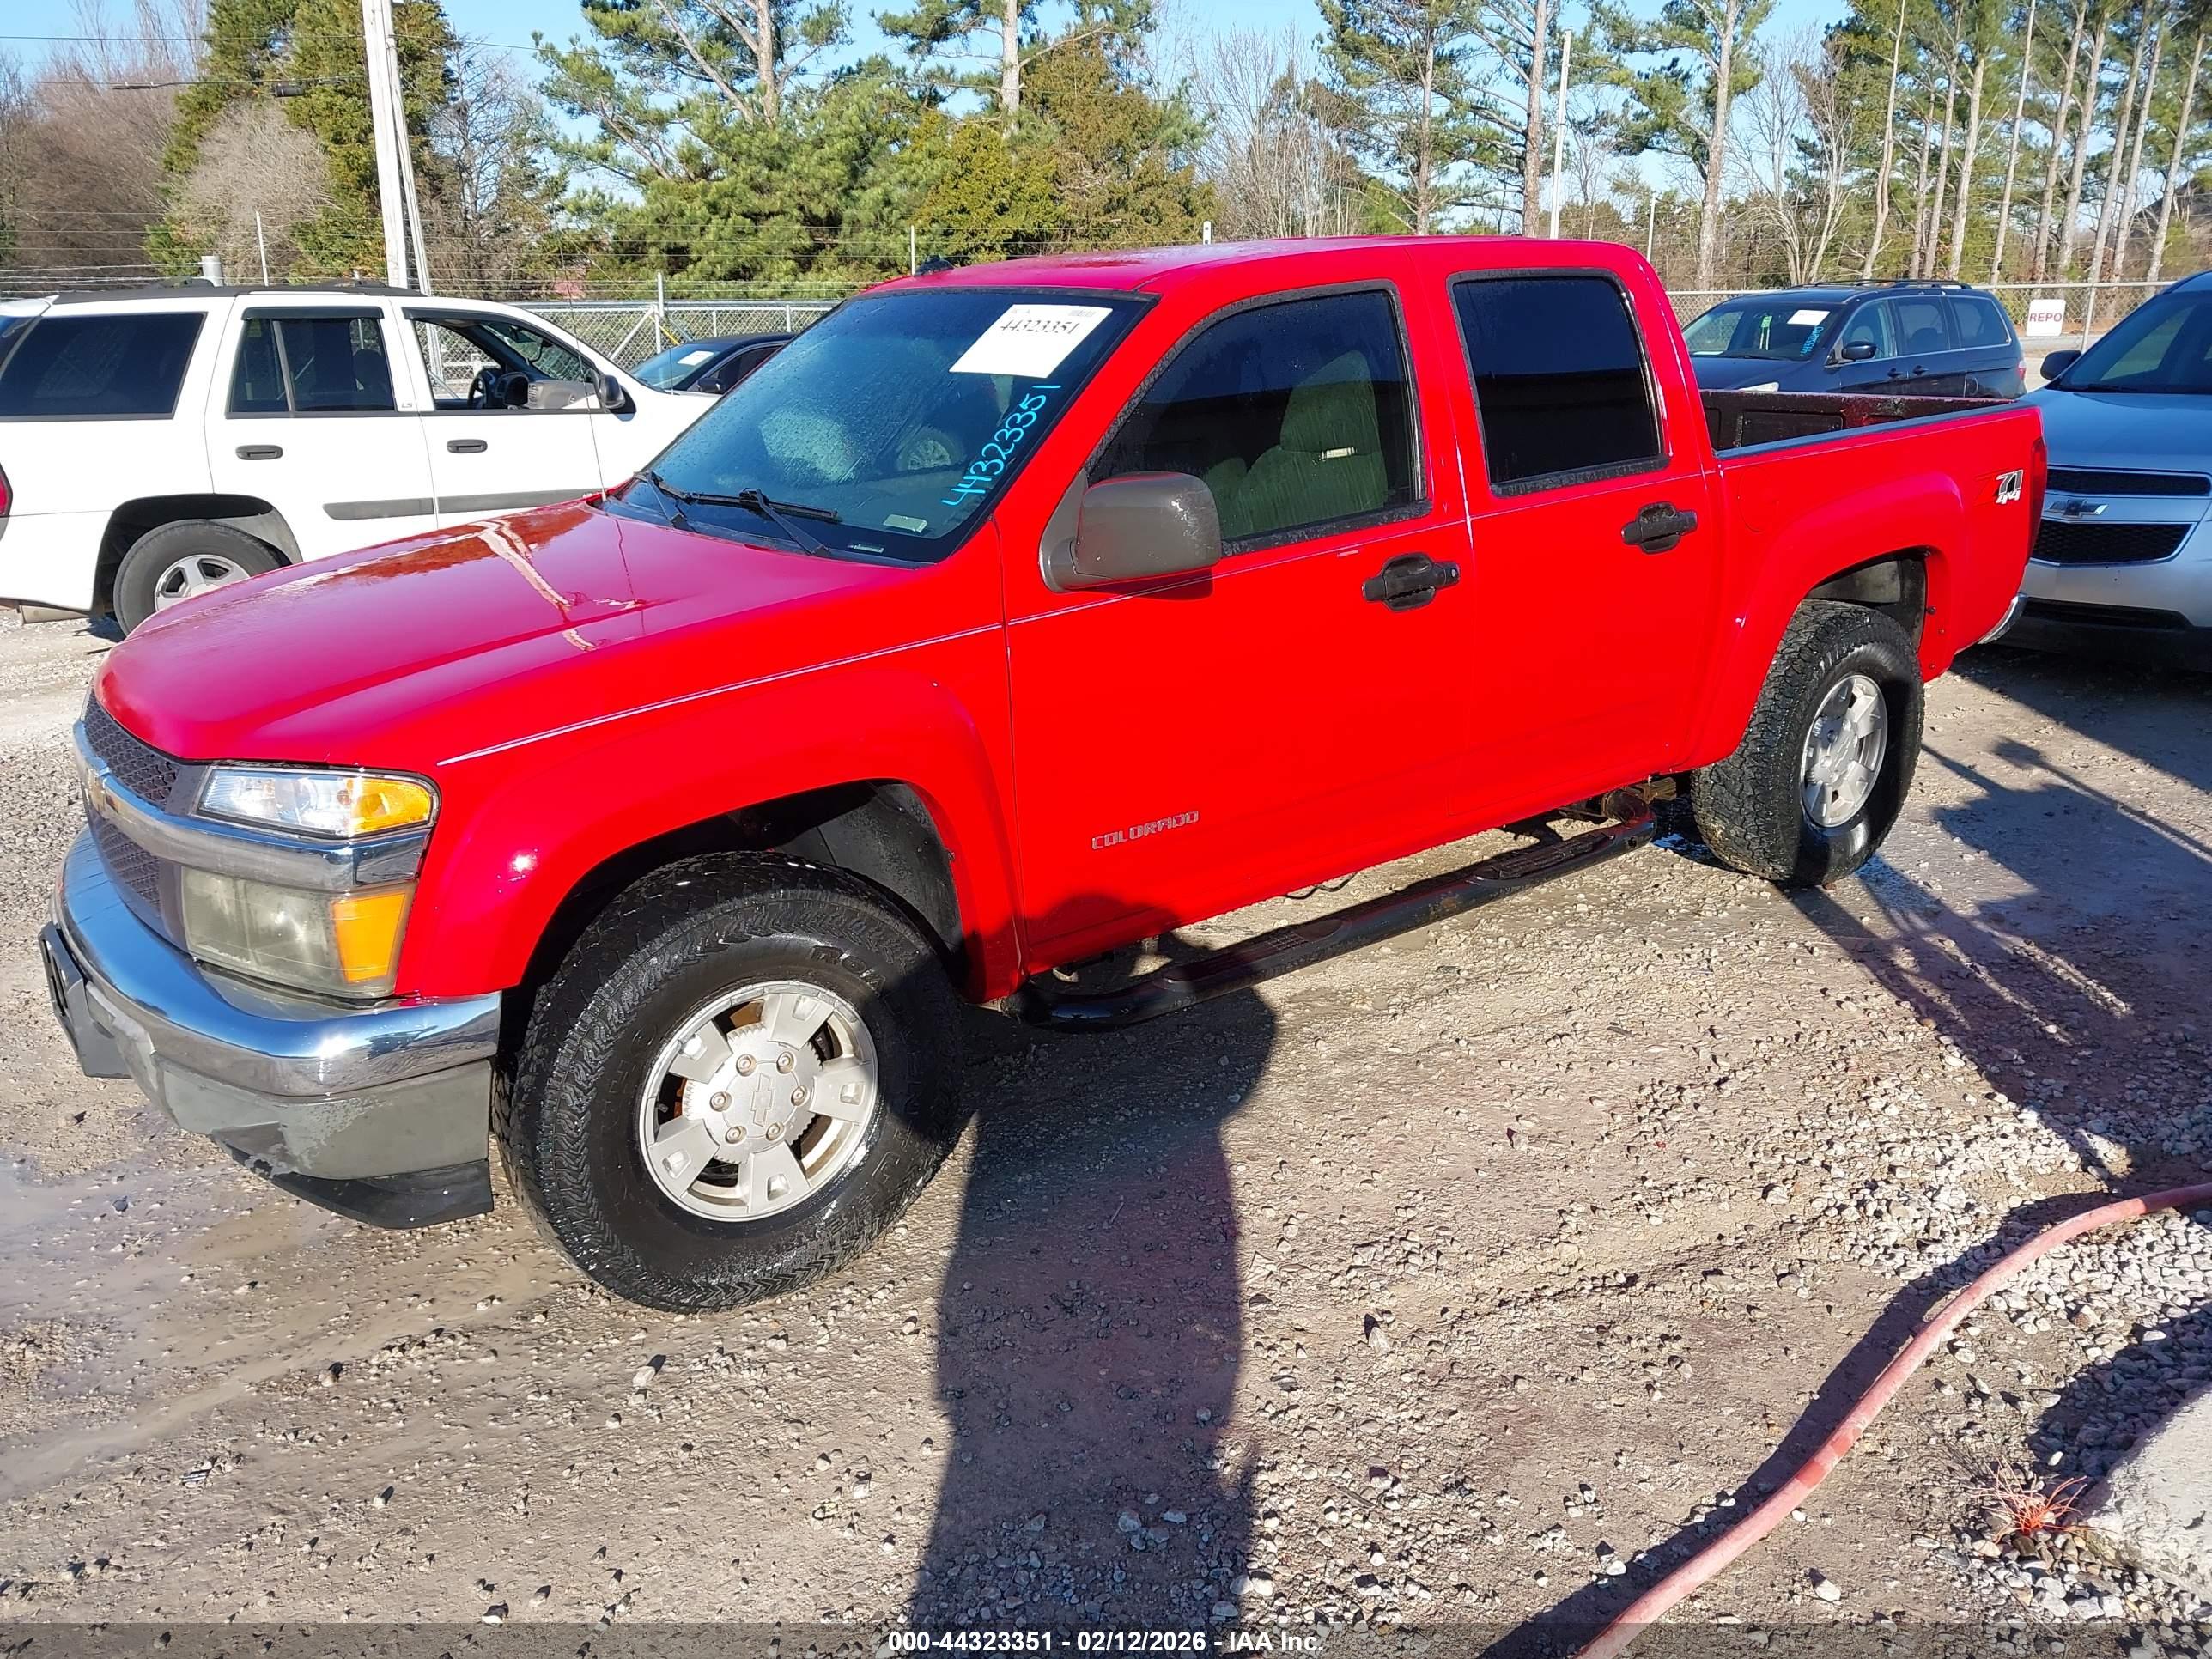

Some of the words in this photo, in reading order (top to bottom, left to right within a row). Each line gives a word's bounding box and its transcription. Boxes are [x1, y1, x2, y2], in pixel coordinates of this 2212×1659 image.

[1000, 319, 1080, 334] 44323351
[2029, 313, 2063, 322] REPO
[941, 385, 1062, 506] 44323351
[1092, 810, 1199, 850] COLORADO
